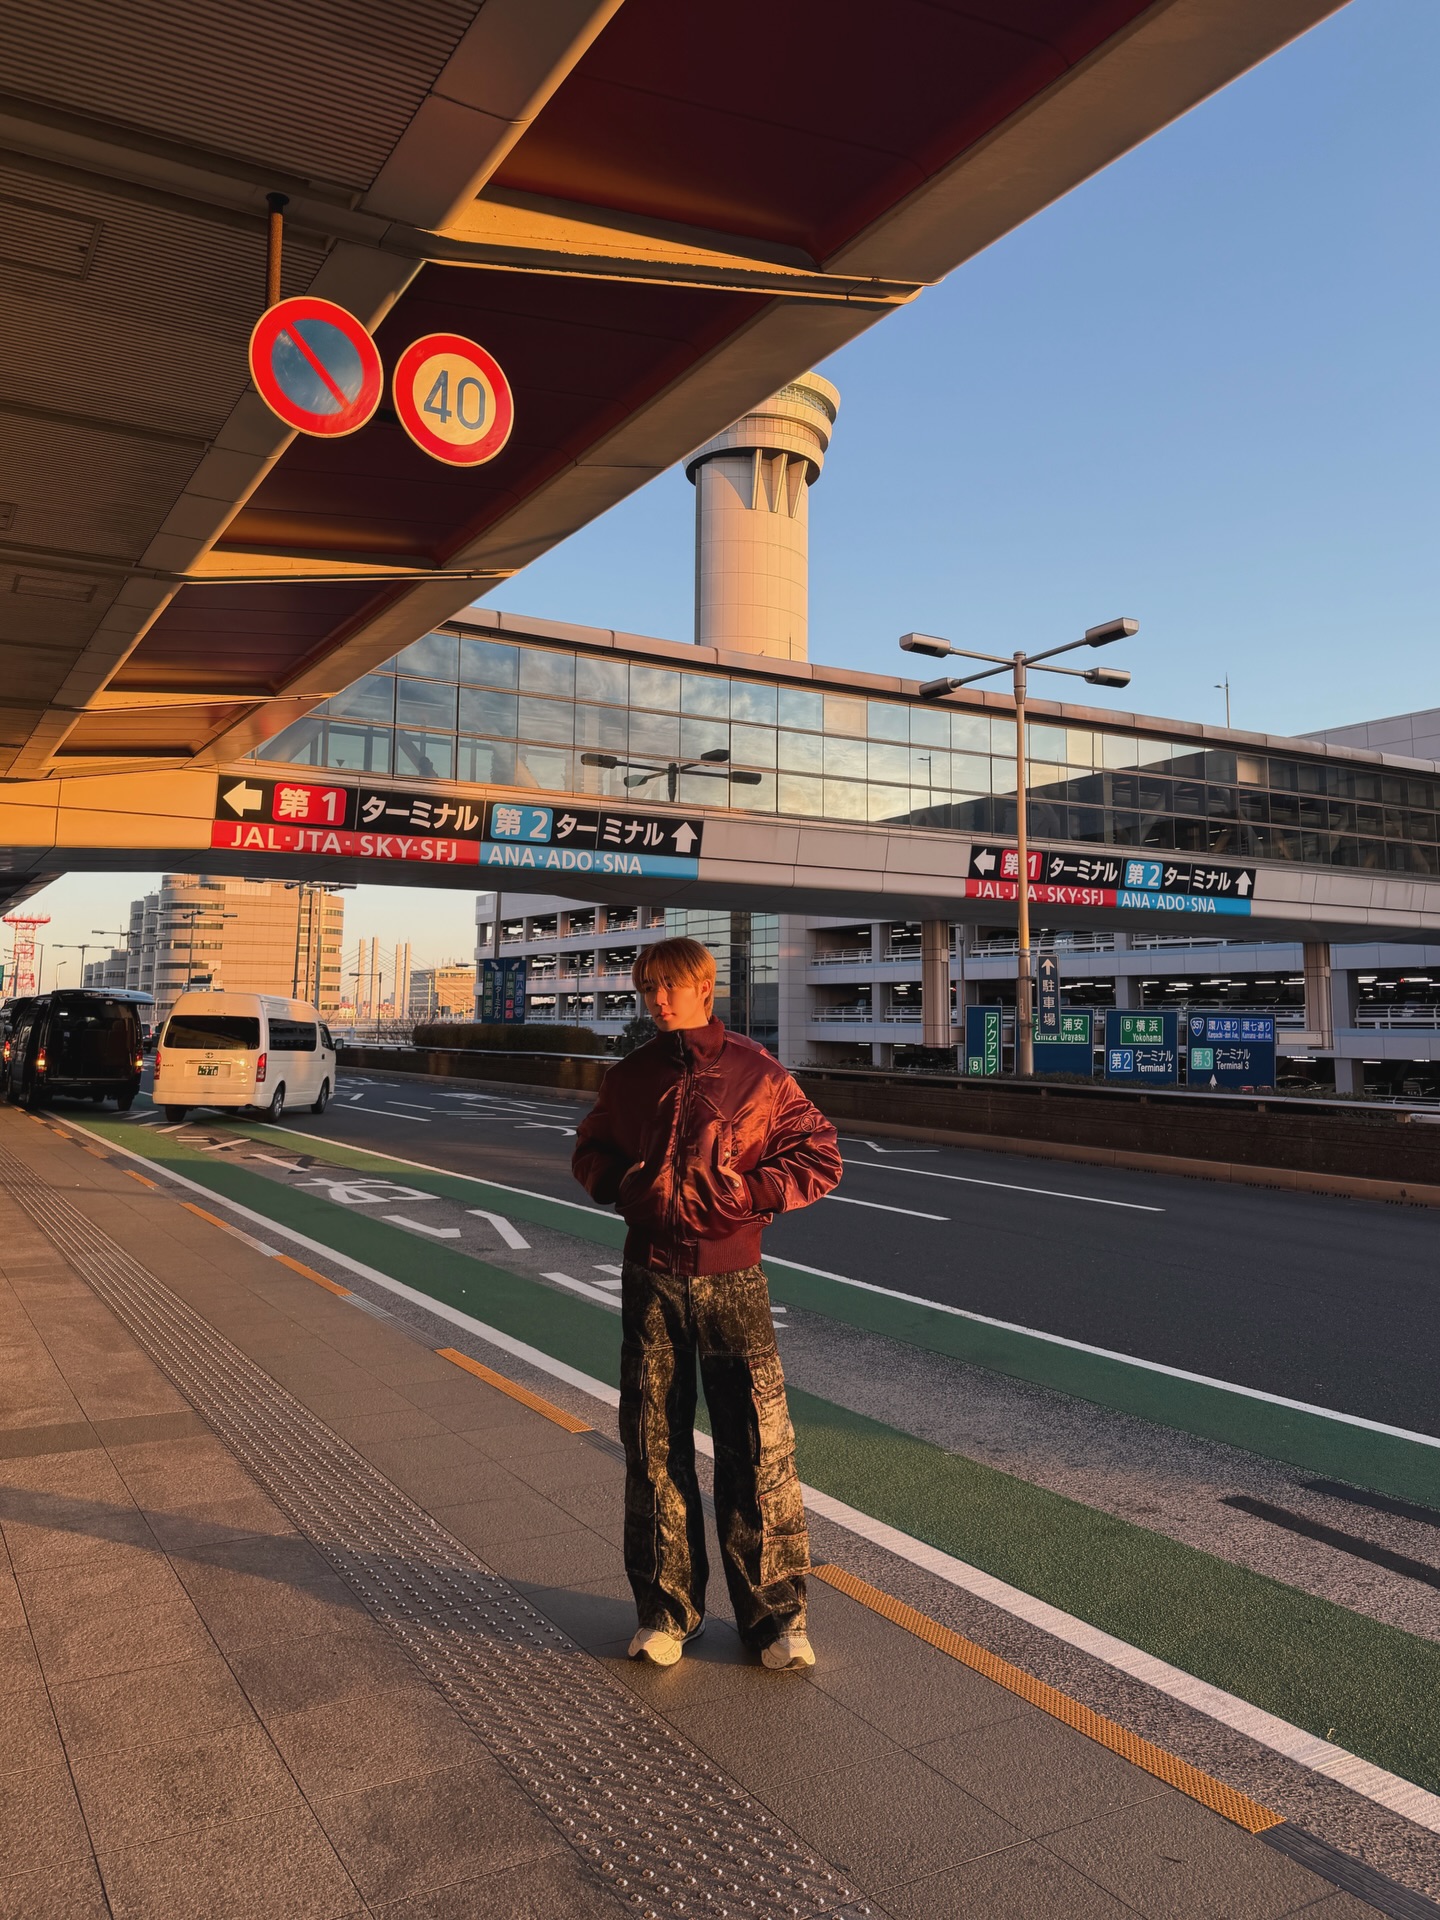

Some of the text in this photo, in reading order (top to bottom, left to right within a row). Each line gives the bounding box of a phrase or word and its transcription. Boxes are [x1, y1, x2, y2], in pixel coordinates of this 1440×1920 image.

[423, 369, 486, 430] 40
[361, 795, 480, 833] ターミナル
[556, 813, 664, 847] ターミナル
[1050, 857, 1118, 883] ターミナル
[1164, 867, 1232, 892] ターミナル
[1042, 979, 1056, 1026] 駐車場
[1136, 1019, 1158, 1032] 横浜
[1133, 1033, 1161, 1042] Yokohama
[1111, 1049, 1173, 1070] 第2 ターミナル
[1137, 1063, 1173, 1072] Terminal 2
[1193, 1048, 1251, 1067] 第3 ターミナル
[1216, 1061, 1250, 1070] Terminal 3
